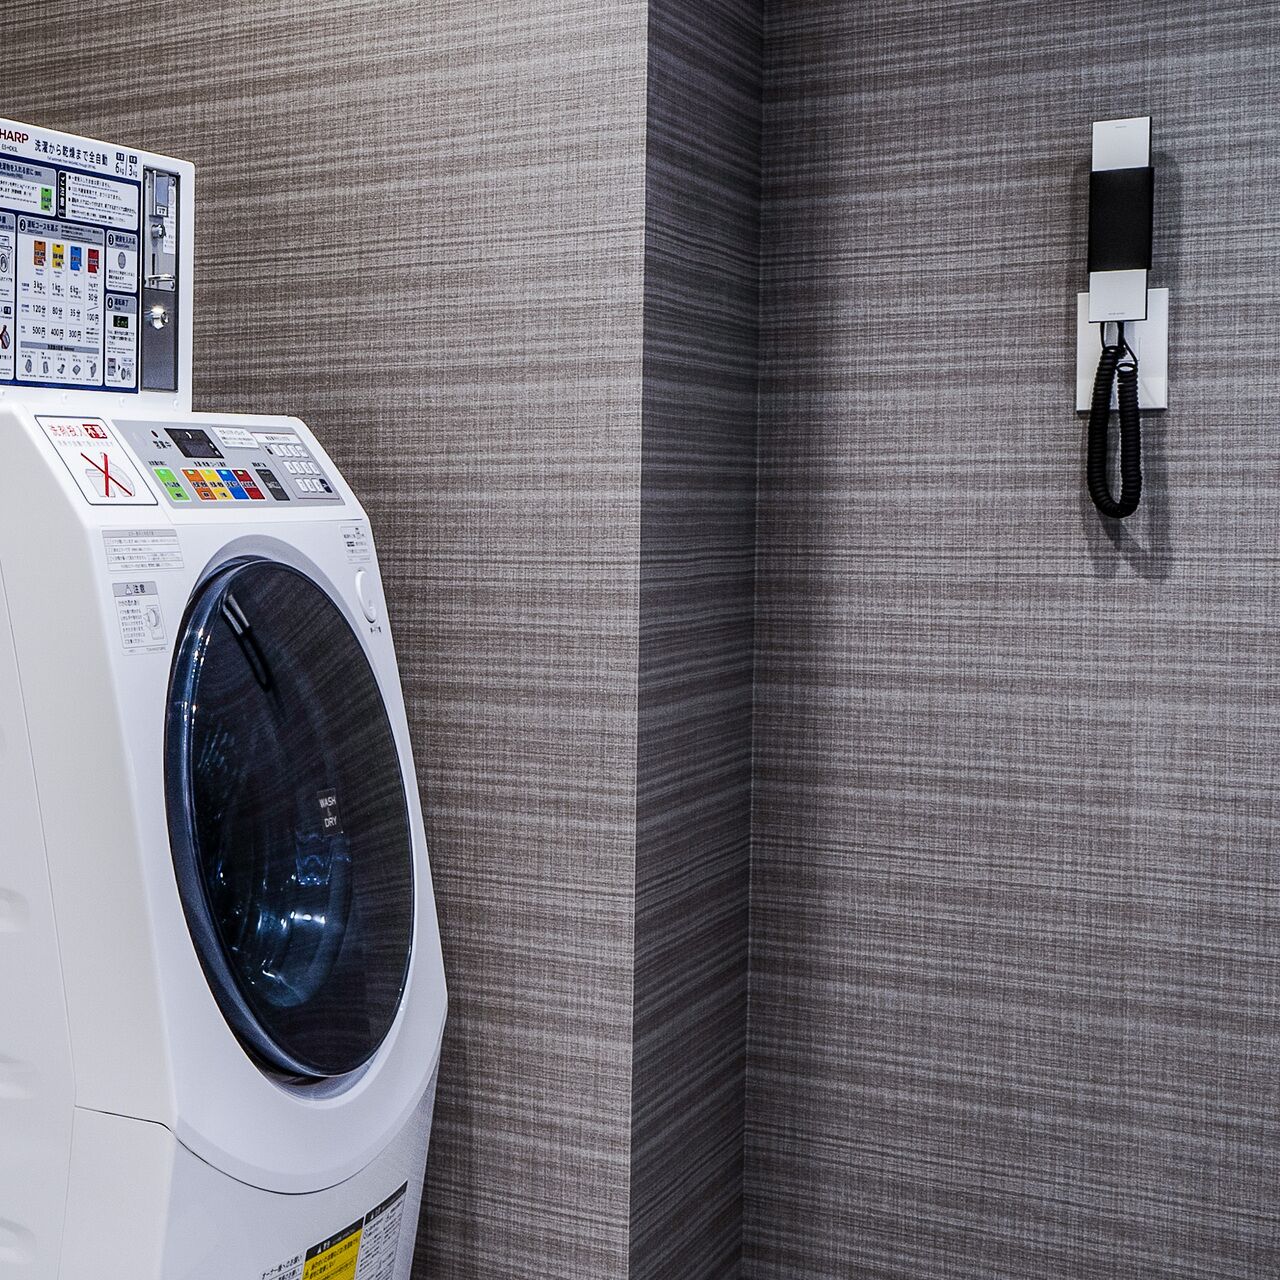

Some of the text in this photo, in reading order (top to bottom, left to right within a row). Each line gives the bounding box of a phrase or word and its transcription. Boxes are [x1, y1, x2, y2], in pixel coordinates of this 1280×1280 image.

[34, 140, 108, 166] 洗濯から乾燥まで全自動
[319, 796, 337, 808] WASH
[324, 816, 338, 828] DRY
